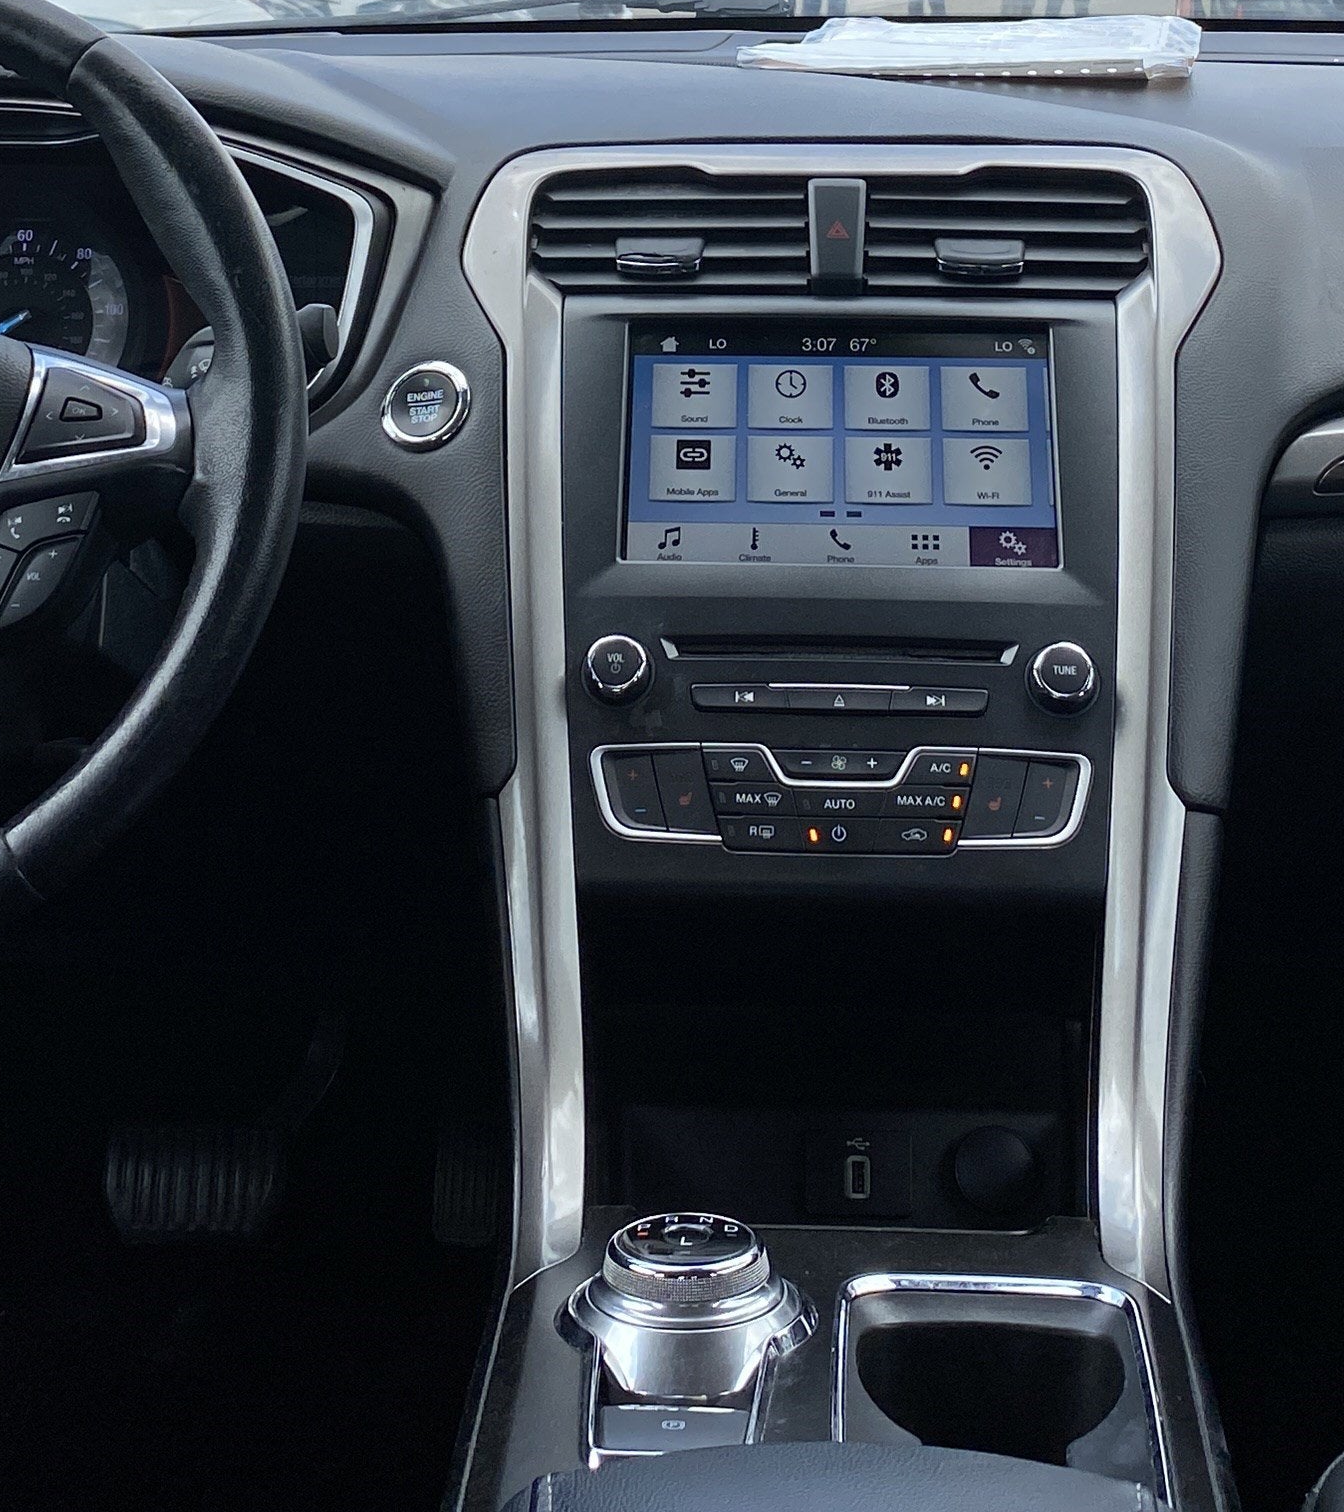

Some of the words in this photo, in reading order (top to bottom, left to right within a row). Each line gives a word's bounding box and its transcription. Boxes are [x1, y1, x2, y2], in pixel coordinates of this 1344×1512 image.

[17, 229, 33, 241] 60
[77, 248, 92, 260] 80
[14, 257, 34, 265] MPH
[709, 338, 727, 349] LO
[801, 337, 837, 352] 3:07
[849, 338, 877, 352] 67°
[995, 341, 1013, 352] LO
[407, 389, 444, 402] ENGINE
[409, 404, 441, 416] START
[411, 413, 438, 424] STOP
[681, 414, 708, 423] Sound
[778, 415, 803, 424] Clock
[867, 416, 908, 425] Bluetooth
[972, 418, 999, 426] Phone
[880, 453, 897, 462] 911
[666, 488, 695, 496] Mobile
[696, 488, 719, 498] Apps
[774, 489, 807, 497] General
[867, 490, 882, 498] 911
[885, 490, 911, 498] Assist
[977, 491, 1000, 500] Wi-Fi
[657, 553, 682, 561] Audio
[827, 554, 855, 563] Phone
[915, 556, 939, 566] Apps
[995, 557, 1032, 566] Settings
[26, 572, 41, 581] VOL
[607, 653, 624, 663] VOL
[1053, 665, 1077, 675] TUNE
[930, 763, 952, 773] A/C
[736, 793, 762, 804] MAX
[897, 795, 923, 806] MAX
[925, 796, 946, 806] A/C
[824, 799, 855, 809] AUTO
[724, 1224, 738, 1232] D
[680, 1236, 693, 1246] L
